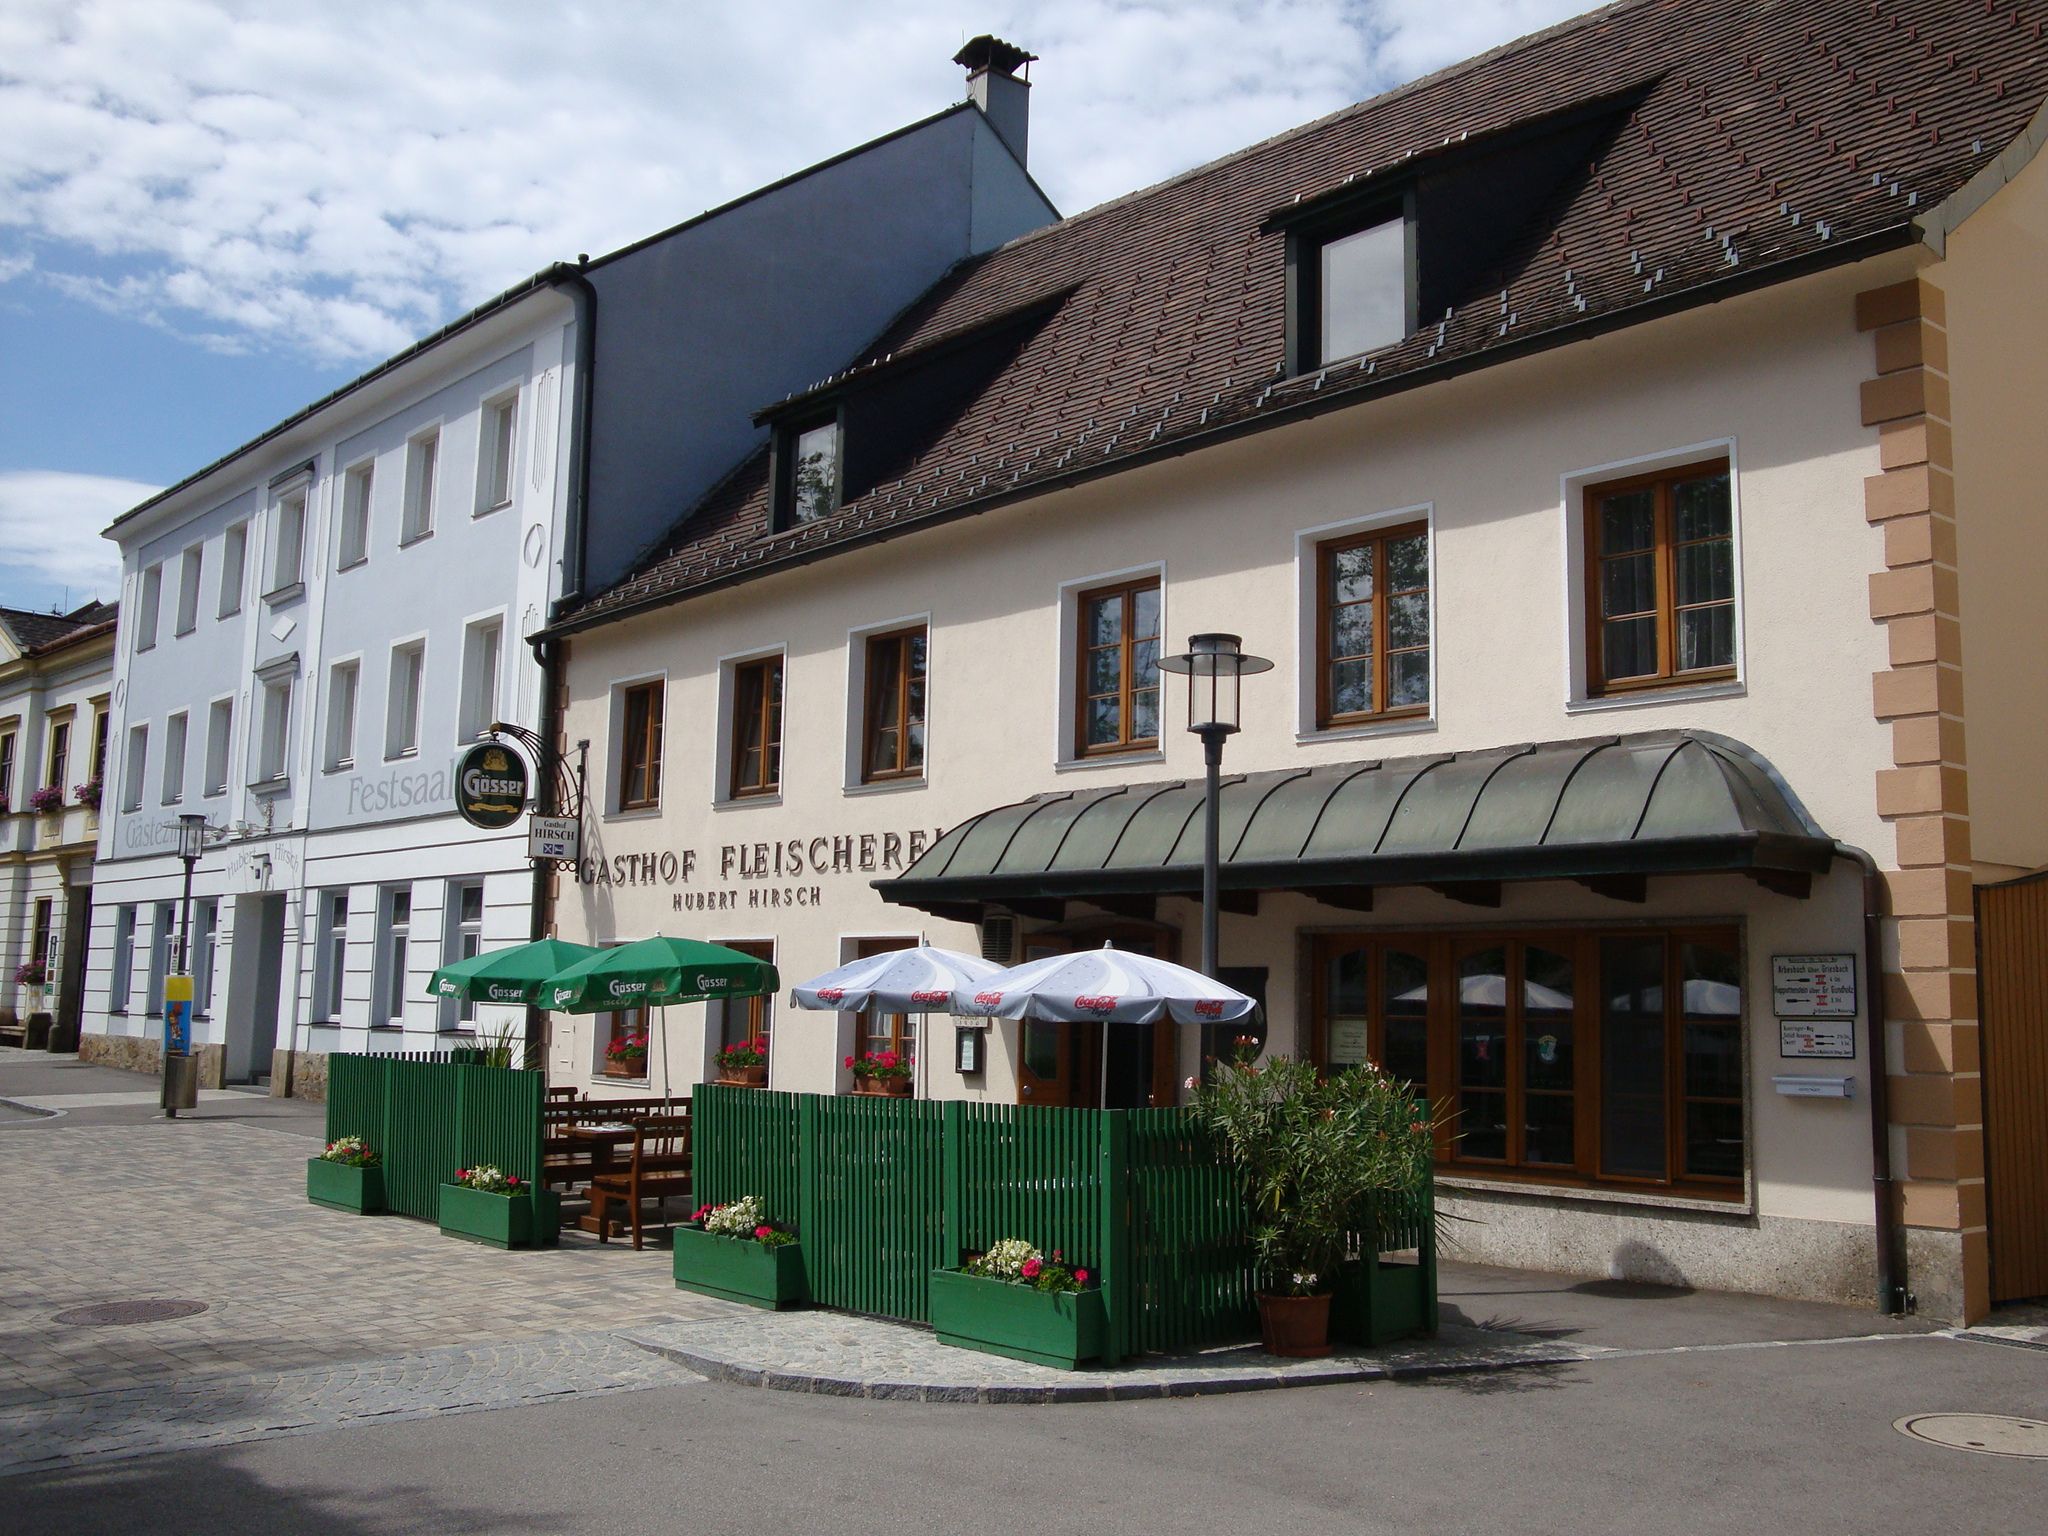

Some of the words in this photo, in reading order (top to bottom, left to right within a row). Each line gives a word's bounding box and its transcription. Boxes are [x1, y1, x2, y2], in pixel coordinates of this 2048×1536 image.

[347, 759, 455, 815] Festsaal
[463, 768, 524, 799] Gösser
[535, 828, 575, 841] HIRSCH
[543, 820, 568, 830] Gasthof
[227, 847, 257, 880] Hubert
[274, 843, 299, 873] Hirsch
[580, 850, 696, 886] GASTHOF
[672, 890, 738, 911] HUBERT
[749, 886, 821, 908] HIRSCH
[609, 979, 647, 997] Gösser
[697, 974, 728, 991] Gösser
